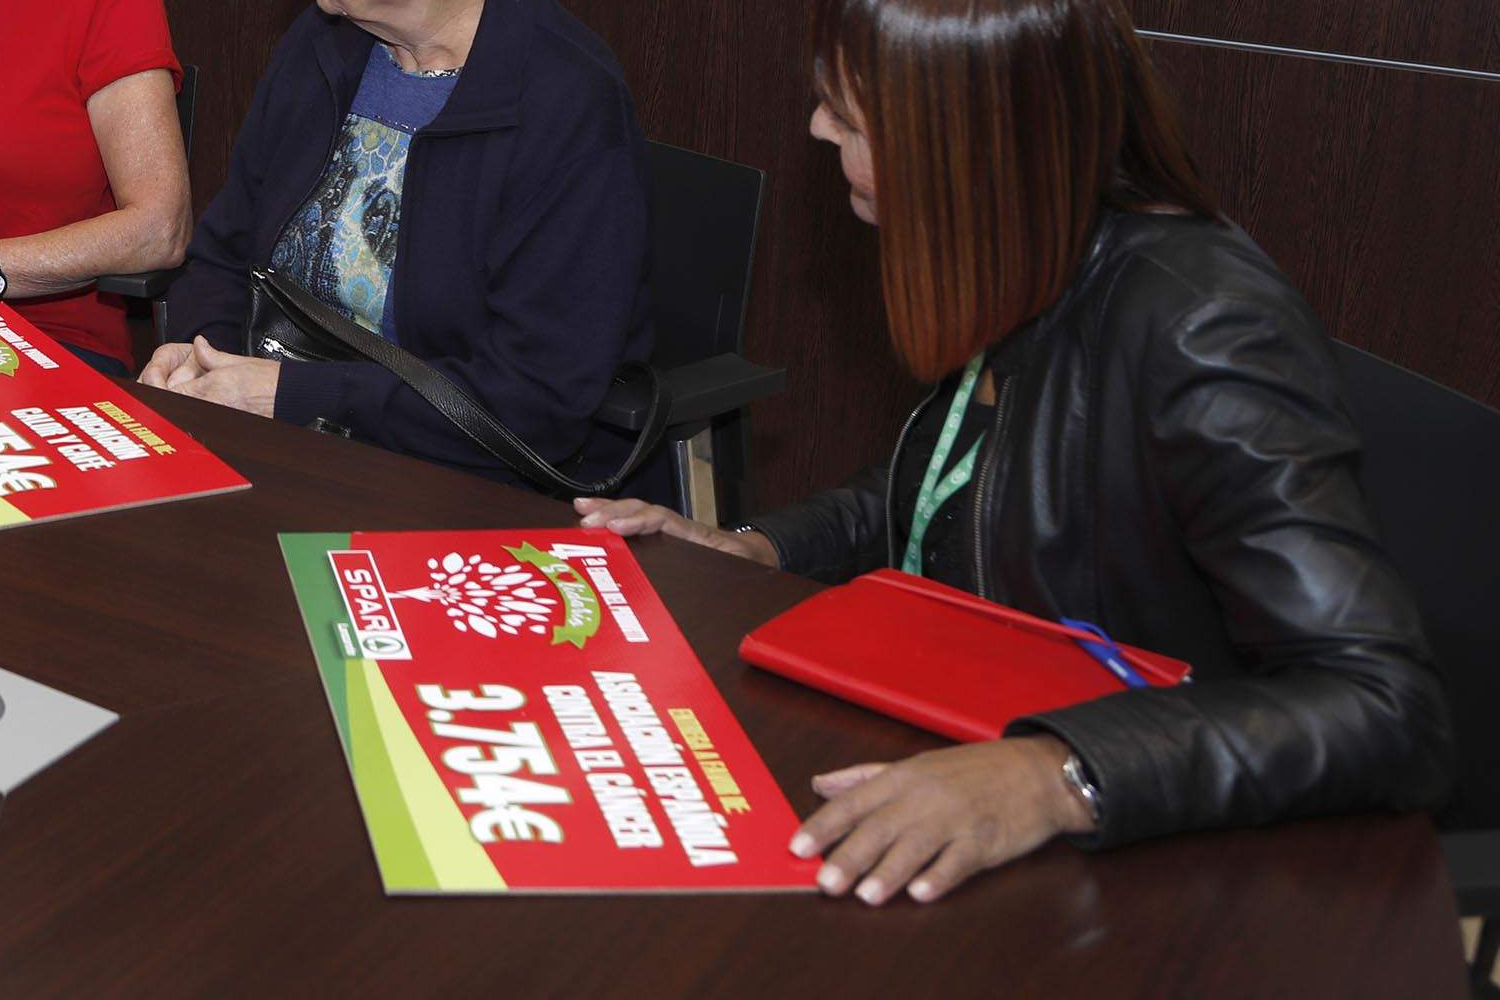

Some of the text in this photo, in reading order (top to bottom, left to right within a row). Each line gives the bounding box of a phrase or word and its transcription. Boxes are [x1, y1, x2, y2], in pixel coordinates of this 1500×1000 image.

[10, 407, 117, 472] CALOR Y CAFÉ
[55, 406, 151, 461] ASOCIACIÓN
[343, 568, 391, 630] SPAR
[416, 684, 573, 846] 3.754€
[541, 684, 664, 849] CONTRA EL CÁNCER
[590, 670, 739, 867] ASOCIACIÓN ESPAÑOLA
